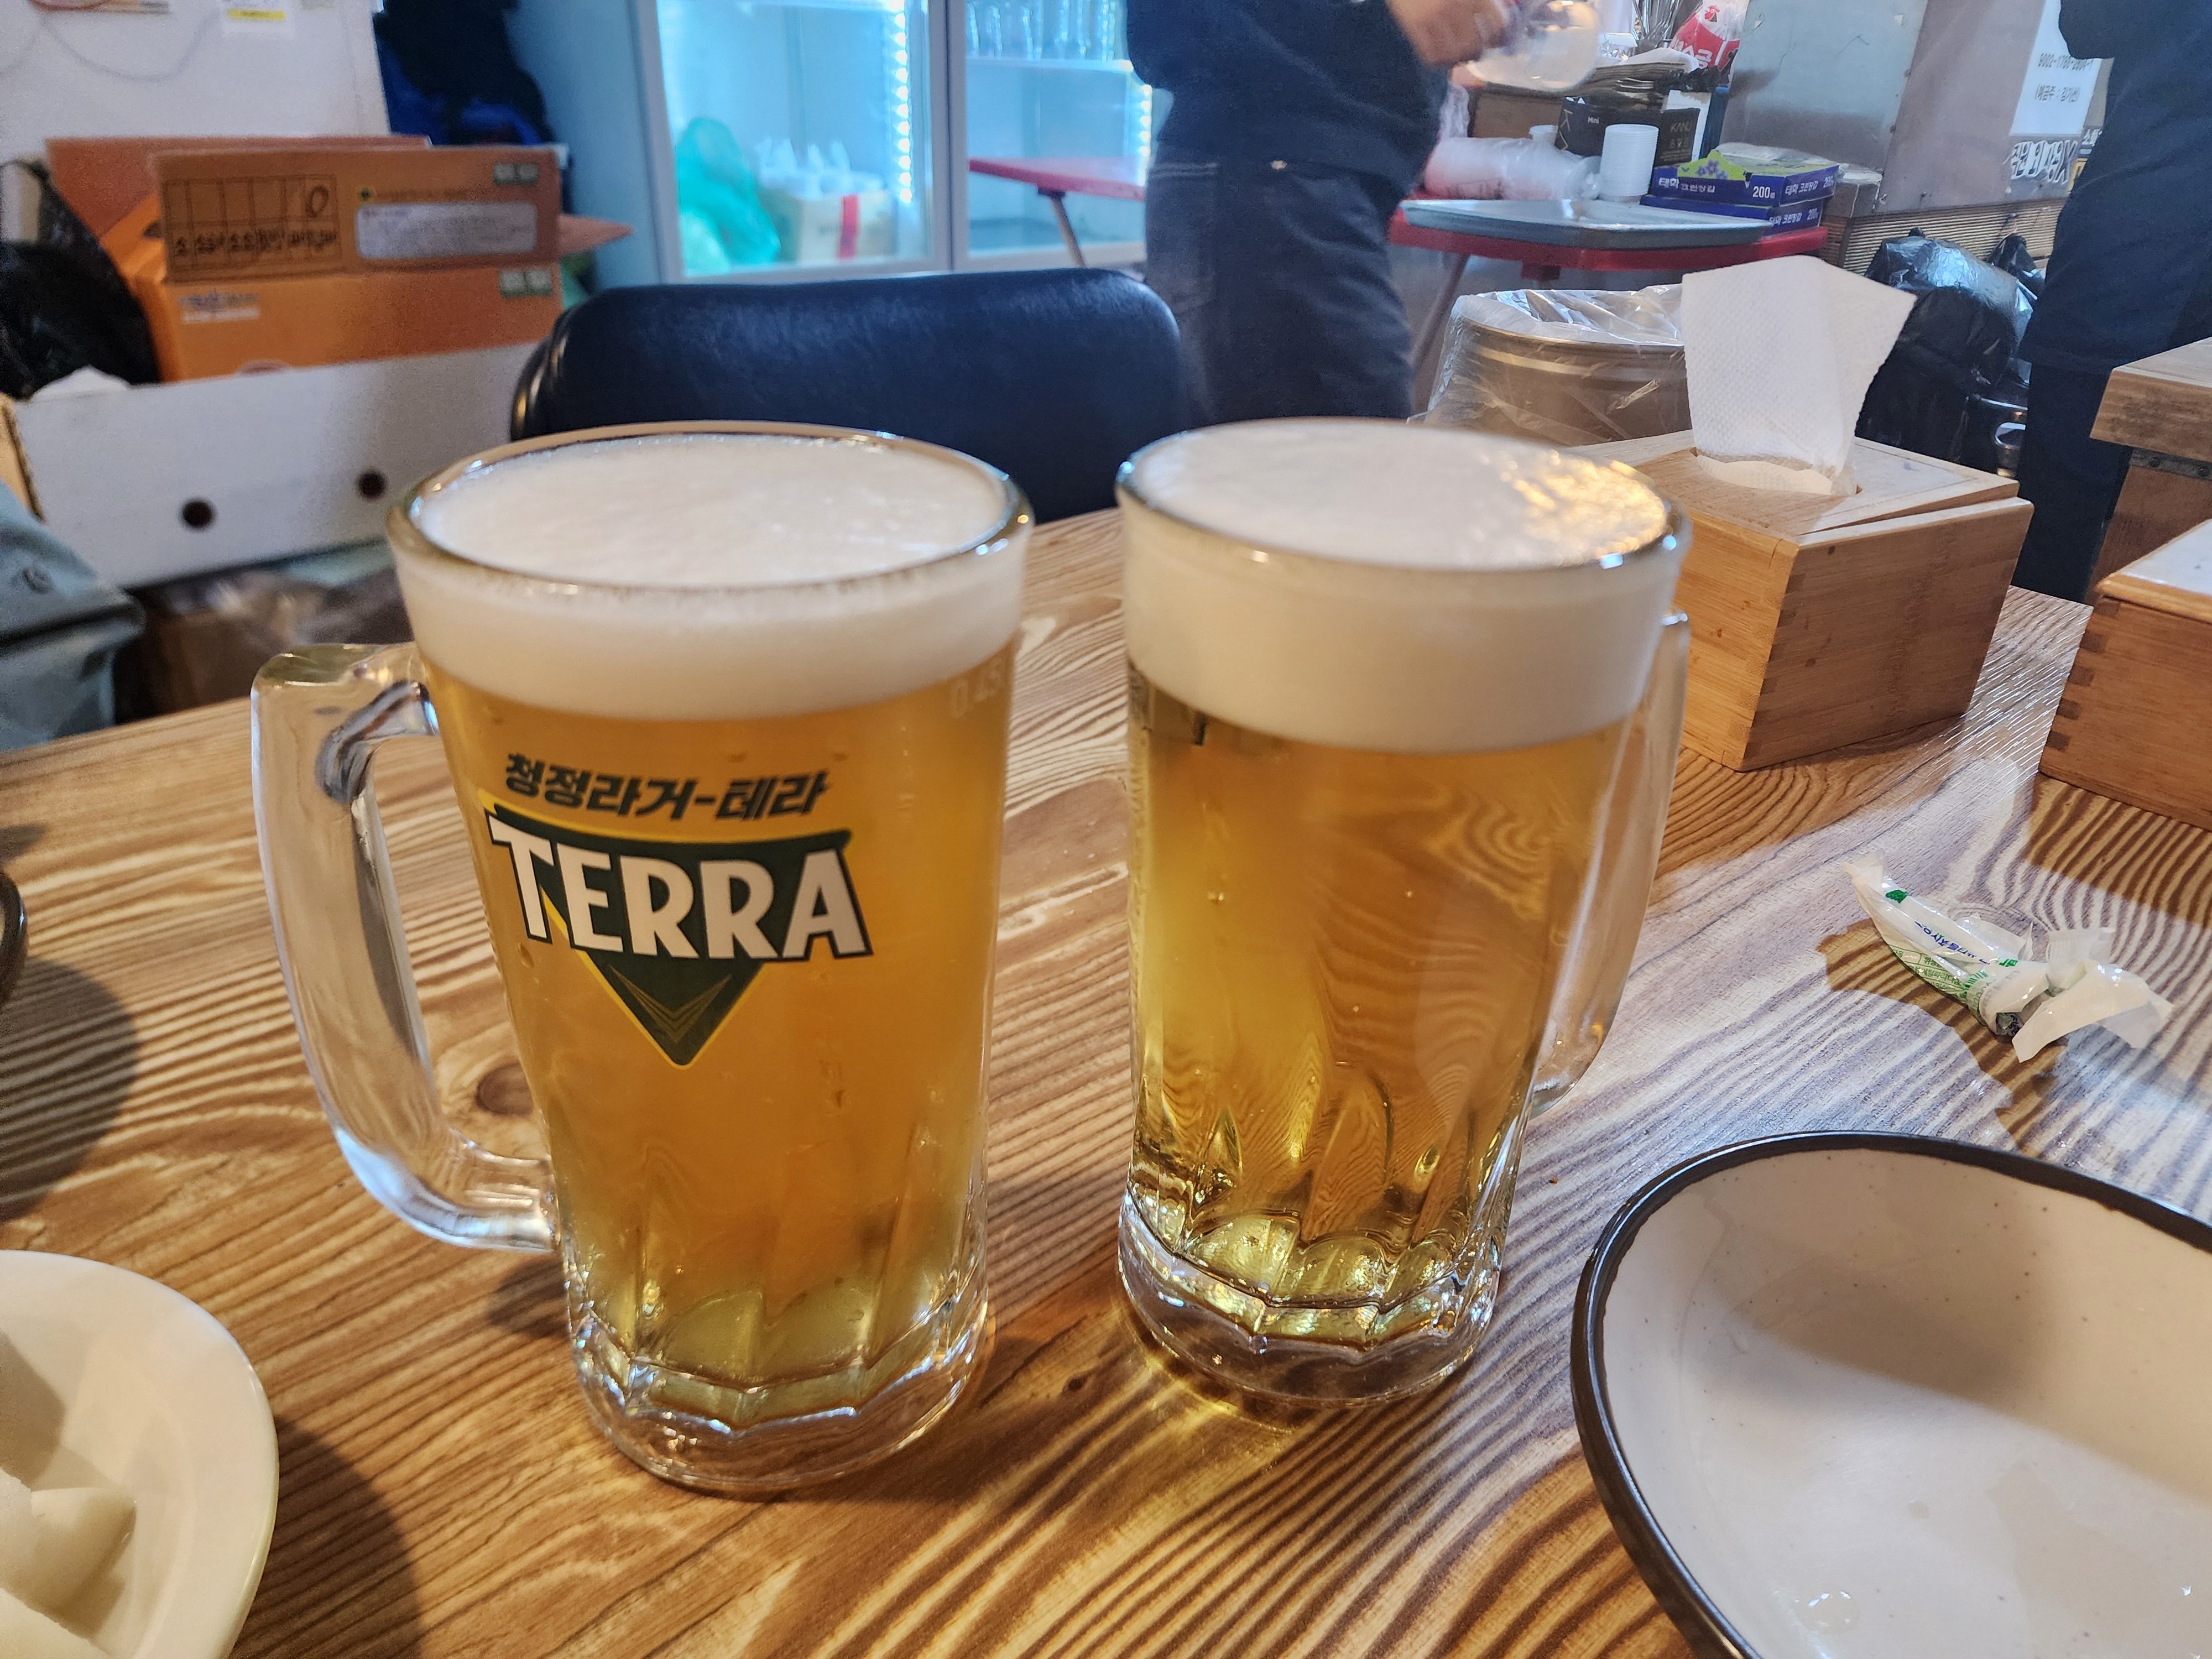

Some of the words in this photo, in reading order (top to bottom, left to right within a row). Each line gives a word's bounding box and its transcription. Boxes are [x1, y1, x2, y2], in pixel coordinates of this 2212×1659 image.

[1670, 122, 1692, 132] KANU
[1658, 177, 1679, 189] 태화
[505, 753, 831, 821] 청정라거-테라
[487, 808, 873, 961] TERRA
